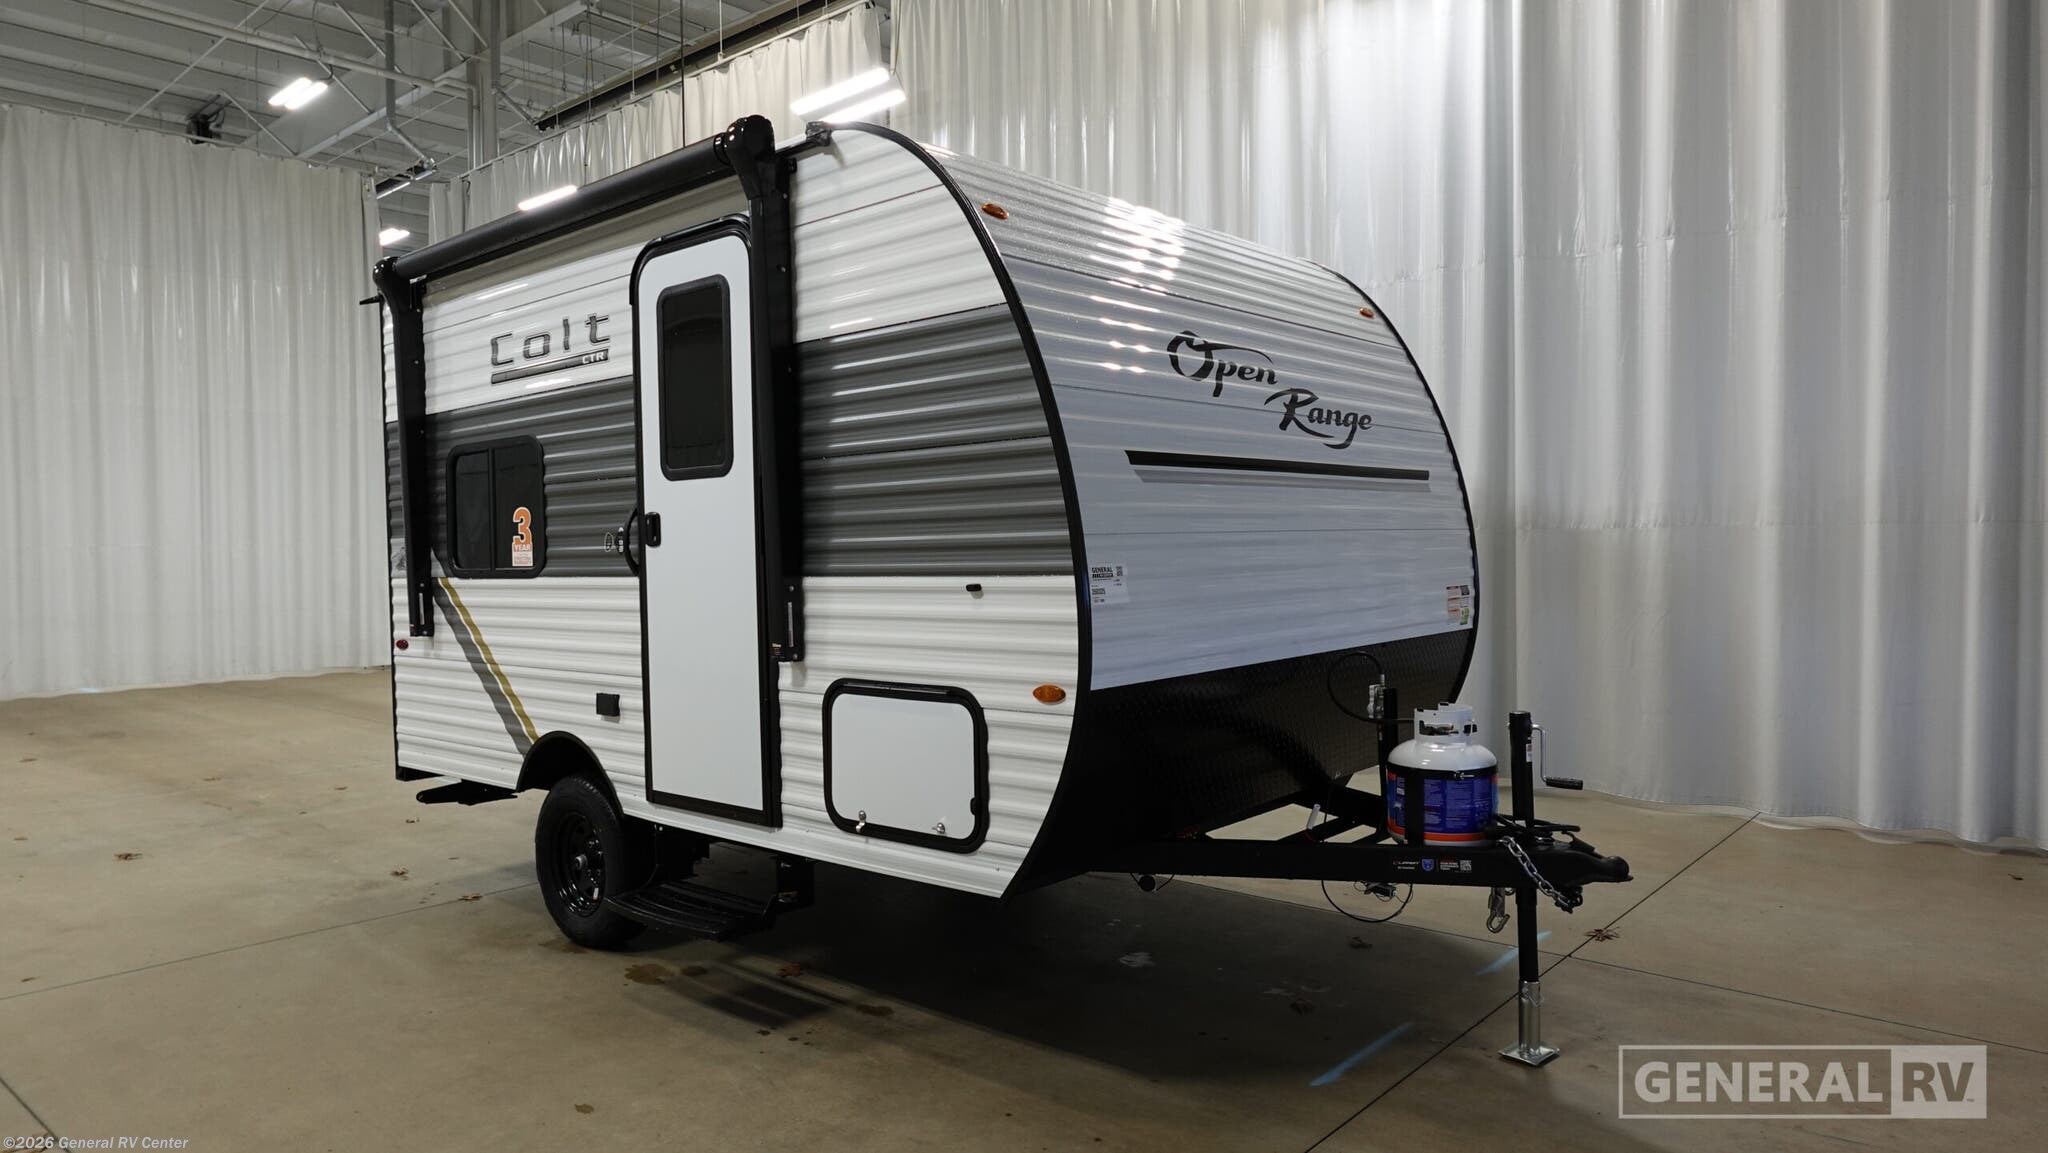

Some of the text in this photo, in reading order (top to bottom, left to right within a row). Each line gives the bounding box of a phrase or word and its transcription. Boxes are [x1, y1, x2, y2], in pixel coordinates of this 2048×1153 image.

[490, 313, 611, 367] Colt
[582, 351, 604, 365] CTR
[1167, 330, 1278, 398] Open
[1264, 387, 1373, 450] Range
[513, 506, 532, 545] 3
